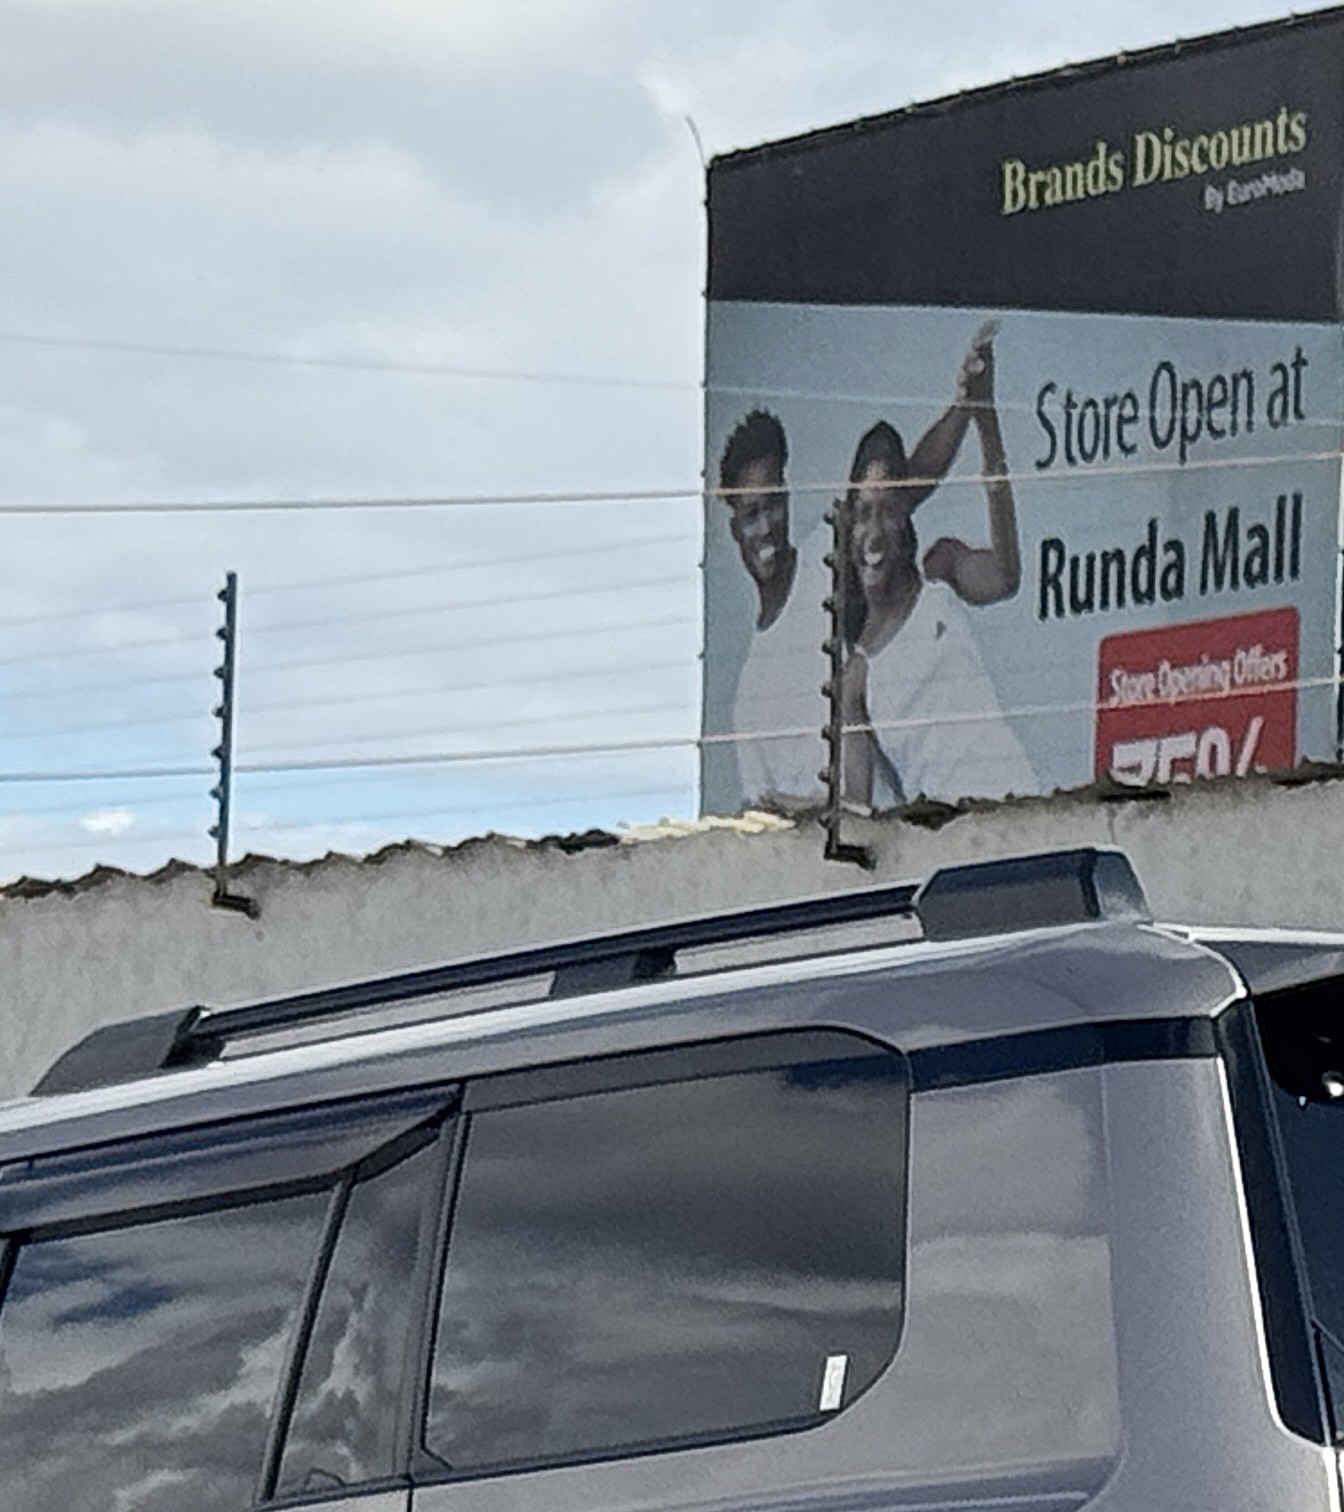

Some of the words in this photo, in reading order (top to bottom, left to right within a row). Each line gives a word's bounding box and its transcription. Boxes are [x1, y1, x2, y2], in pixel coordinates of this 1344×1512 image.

[1001, 141, 1124, 215] Brands
[1132, 106, 1308, 188] Discounts
[1204, 184, 1224, 214] By
[1035, 381, 1139, 470] Store
[1149, 360, 1254, 465] Open
[1267, 346, 1308, 429] at
[1038, 517, 1185, 622] Runda
[1199, 491, 1303, 596] Mall
[1110, 668, 1155, 706] Store
[1158, 653, 1231, 704] Opening
[1233, 645, 1288, 685] Offers
